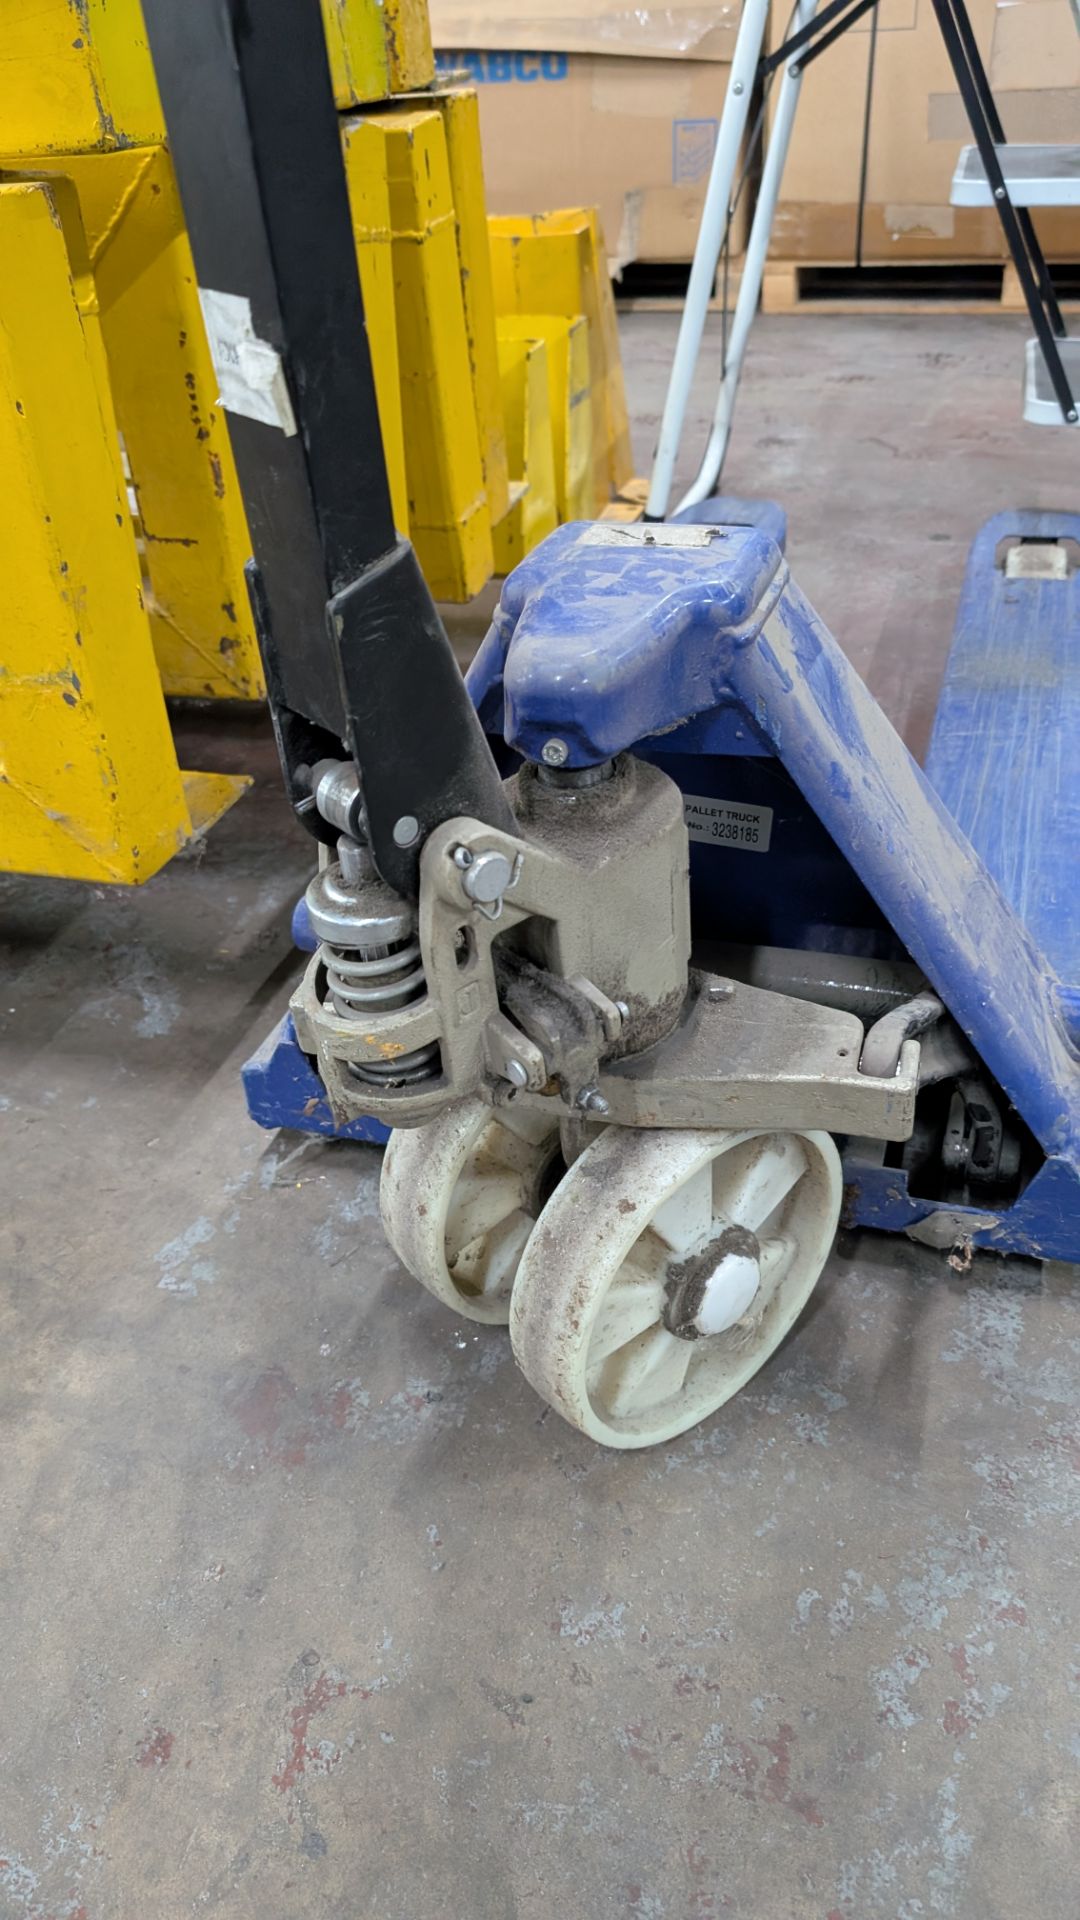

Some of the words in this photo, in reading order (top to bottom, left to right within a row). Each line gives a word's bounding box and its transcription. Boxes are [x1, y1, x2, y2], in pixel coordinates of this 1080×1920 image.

[685, 804, 724, 818] PALLET
[726, 810, 760, 824] TRUCK
[711, 822, 759, 843] 3238185
